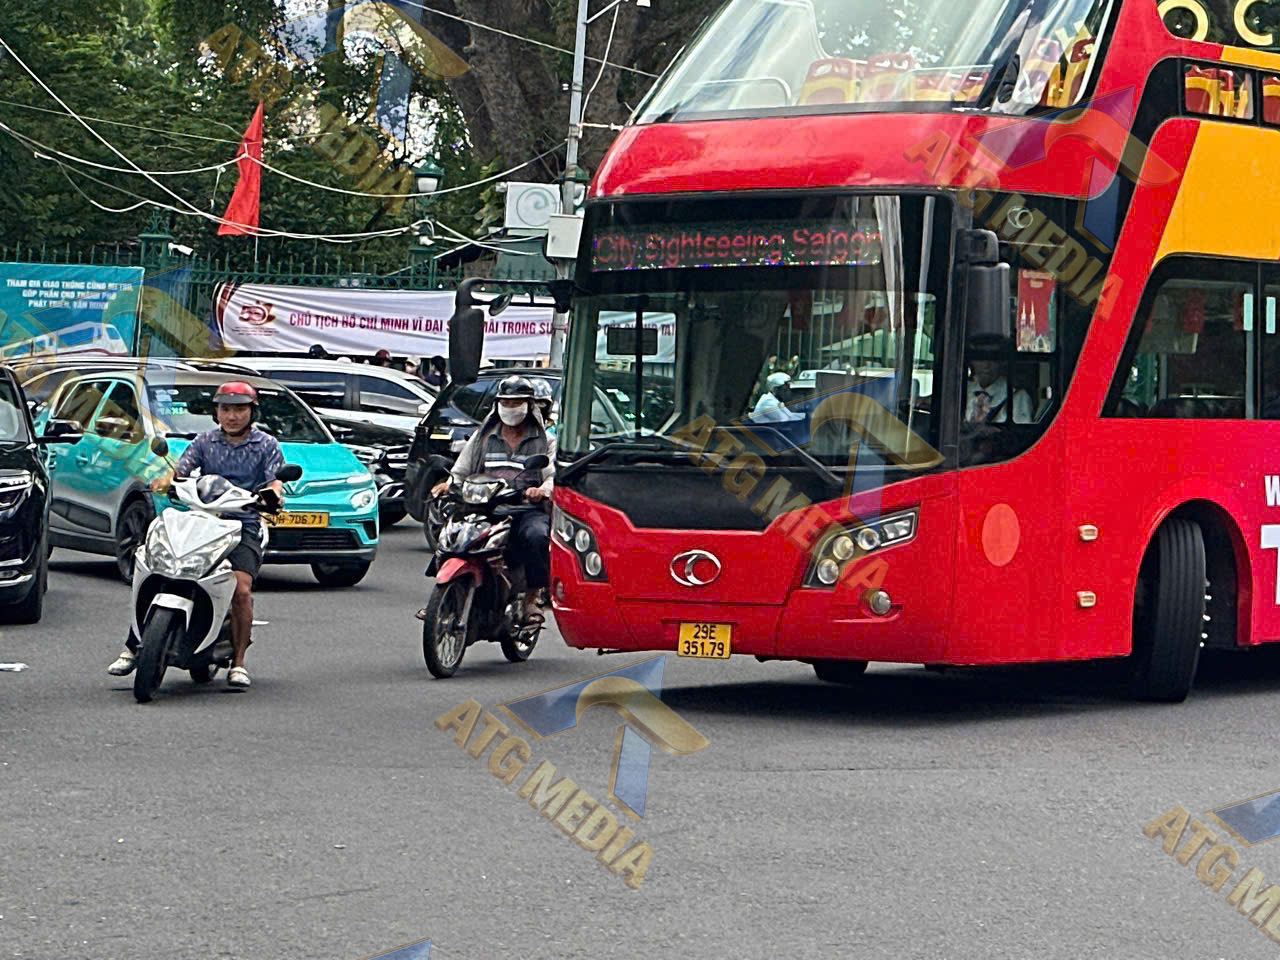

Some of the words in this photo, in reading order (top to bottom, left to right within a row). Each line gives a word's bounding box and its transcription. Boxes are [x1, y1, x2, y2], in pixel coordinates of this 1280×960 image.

[645, 232, 782, 267] Sightseeing
[792, 228, 881, 263] Saigon
[314, 314, 338, 330] TỊCH
[380, 317, 409, 331] MINH
[502, 322, 536, 334] TRONG
[693, 624, 717, 640] 29E
[682, 640, 725, 656] 351.79
